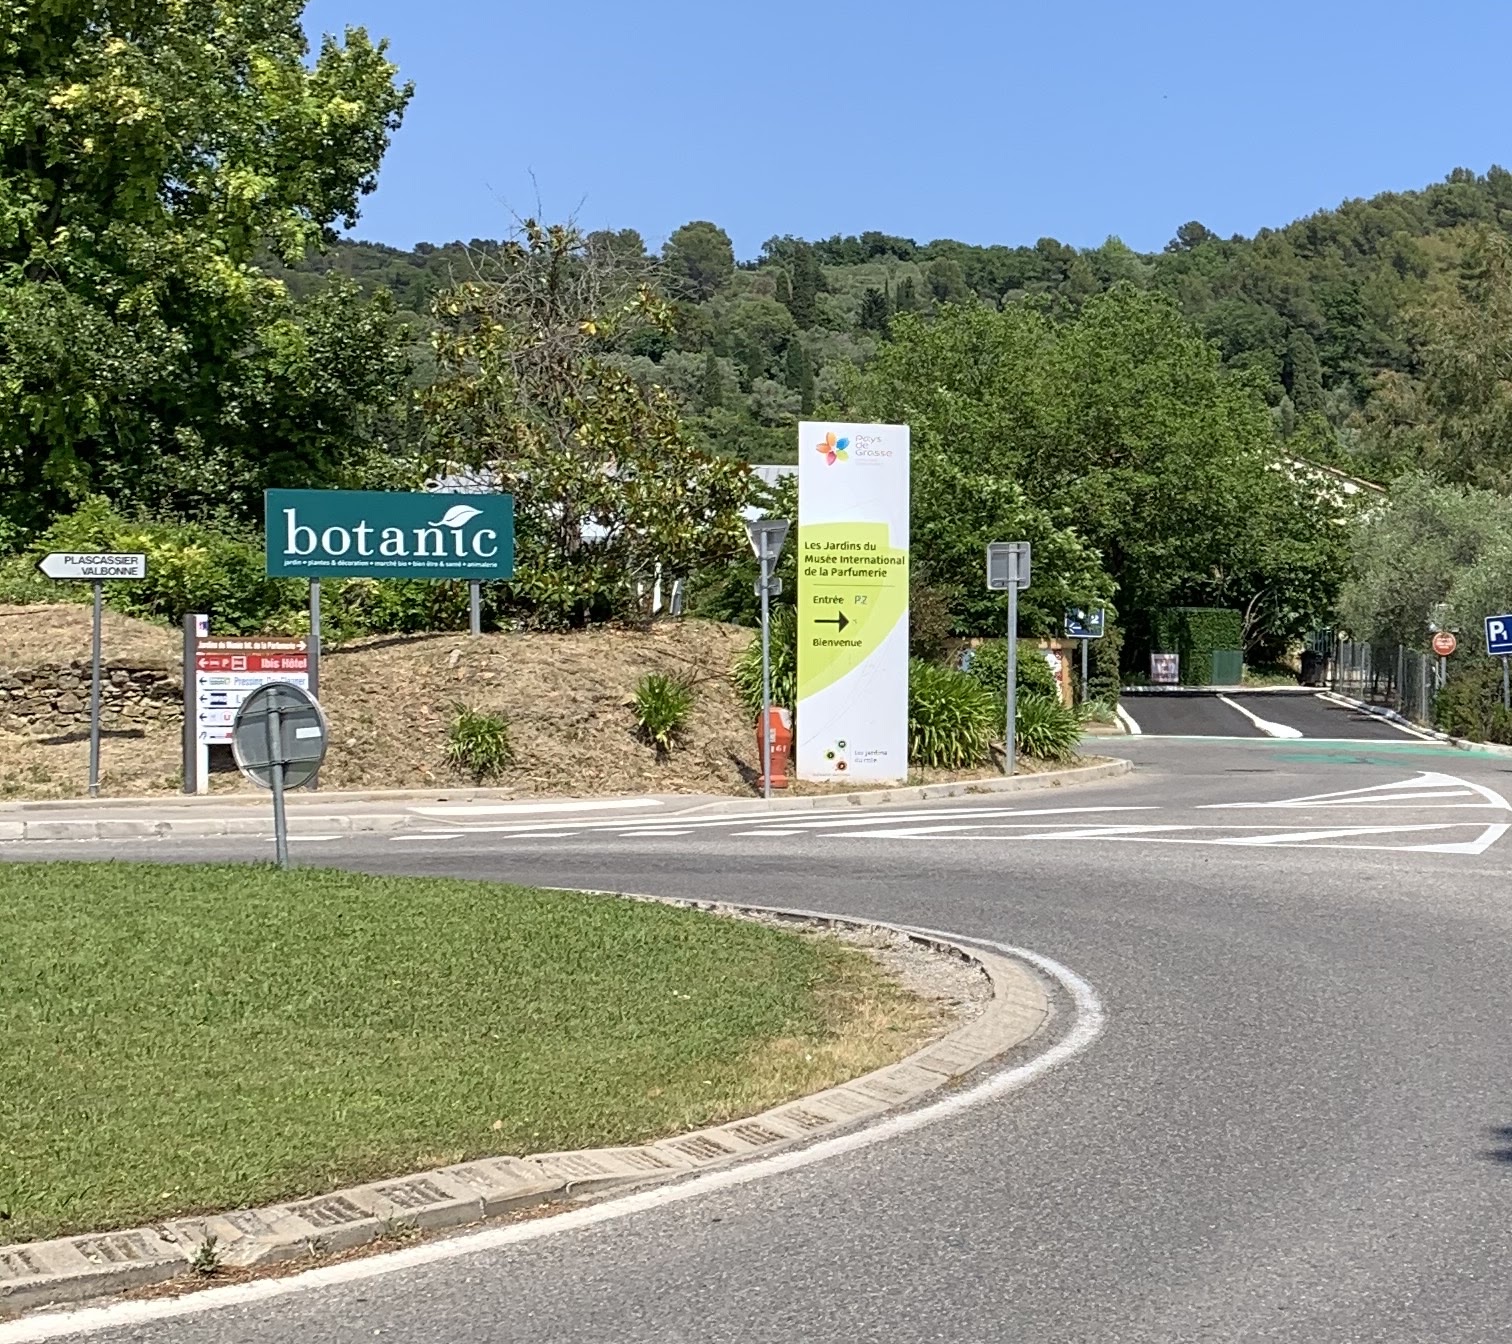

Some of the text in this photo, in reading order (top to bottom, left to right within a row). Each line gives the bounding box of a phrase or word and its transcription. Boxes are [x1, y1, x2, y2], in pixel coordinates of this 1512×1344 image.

[283, 505, 498, 557] botanic
[804, 541, 876, 551] Les Jardins du
[64, 556, 139, 565] PLASCASSIER
[804, 555, 905, 565] Musée International
[81, 567, 138, 576] VALBONNE
[804, 567, 887, 577] de la Parfumerie
[813, 595, 844, 604] Entrée
[812, 638, 863, 647] Bienvenue
[261, 658, 280, 668] Ibis
[281, 658, 307, 669] Hôtel
